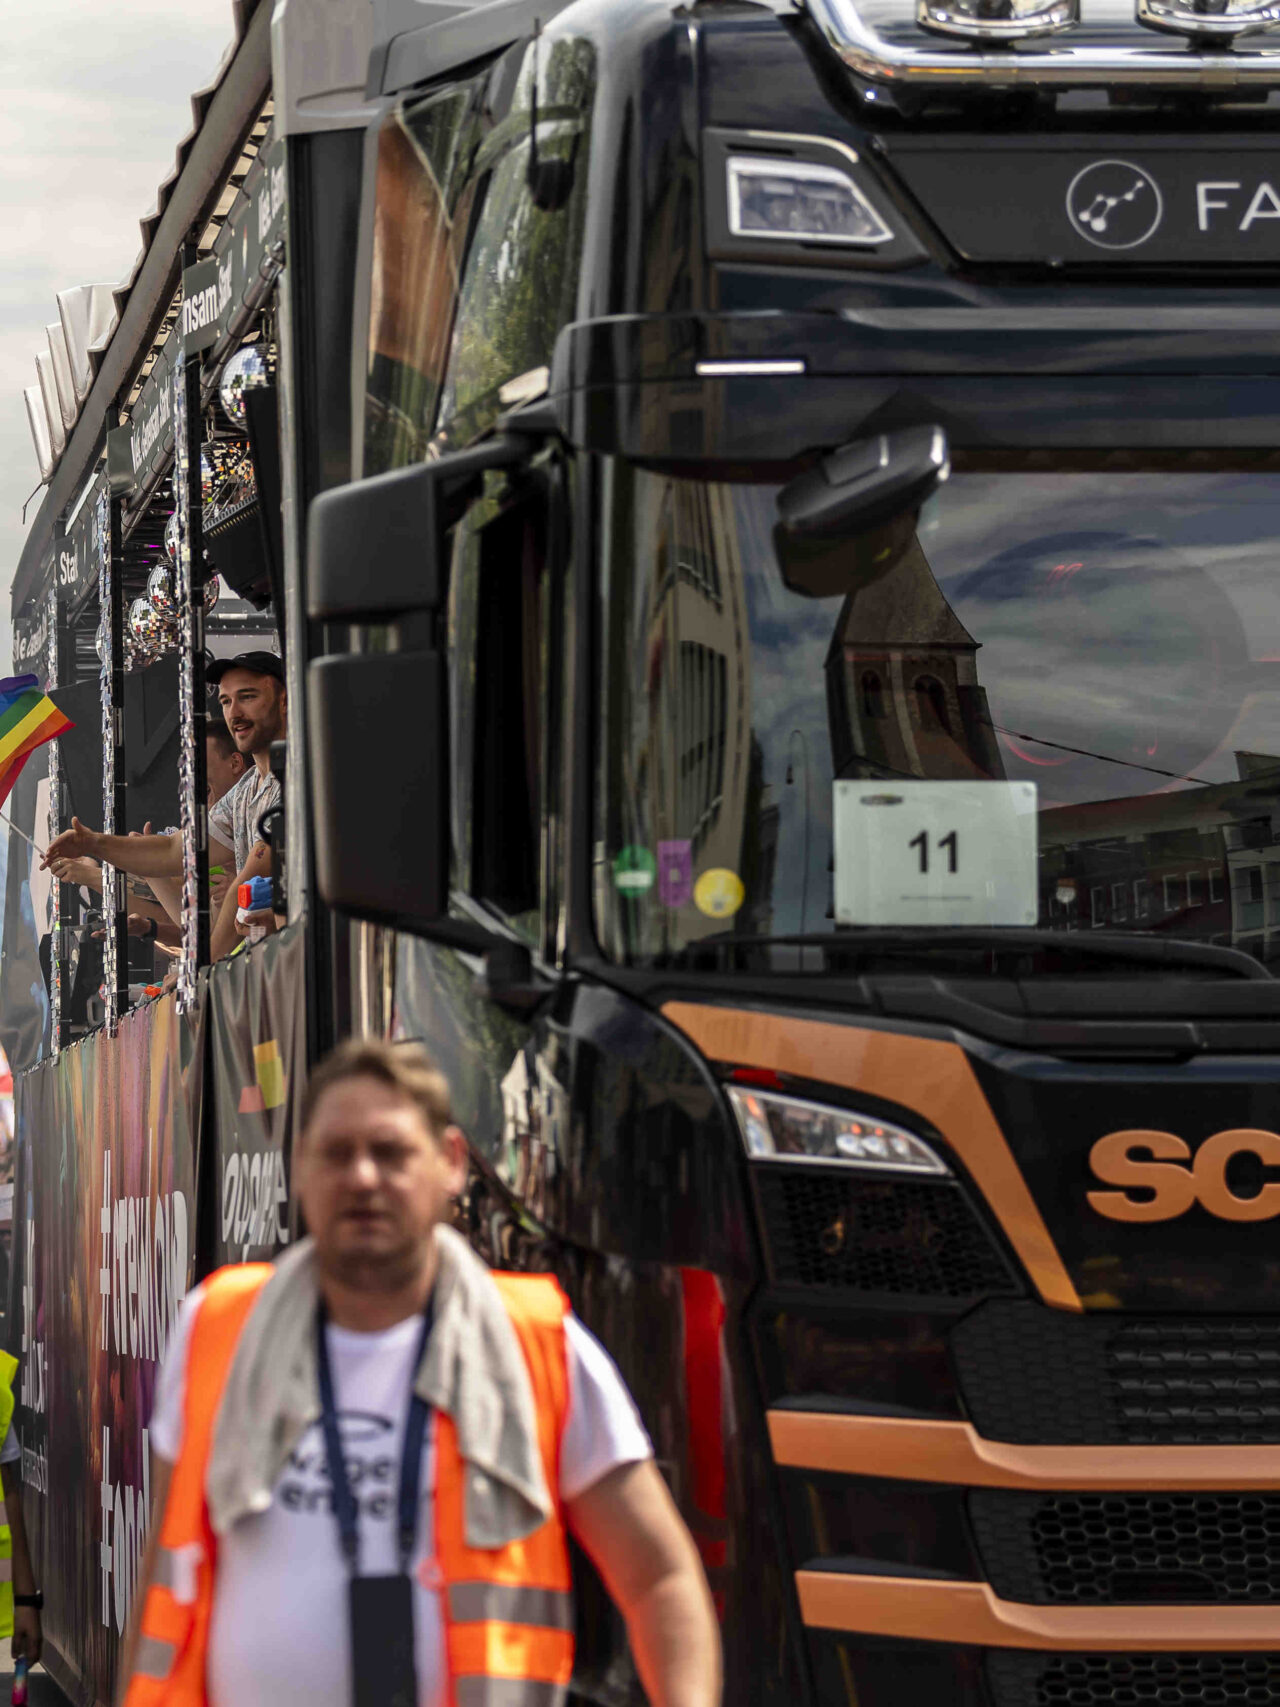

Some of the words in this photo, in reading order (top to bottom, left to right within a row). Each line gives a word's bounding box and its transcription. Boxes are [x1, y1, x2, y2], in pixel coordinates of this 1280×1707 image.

[1196, 181, 1280, 231] FA
[909, 830, 960, 874] 11
[1086, 1128, 1280, 1224] SC
